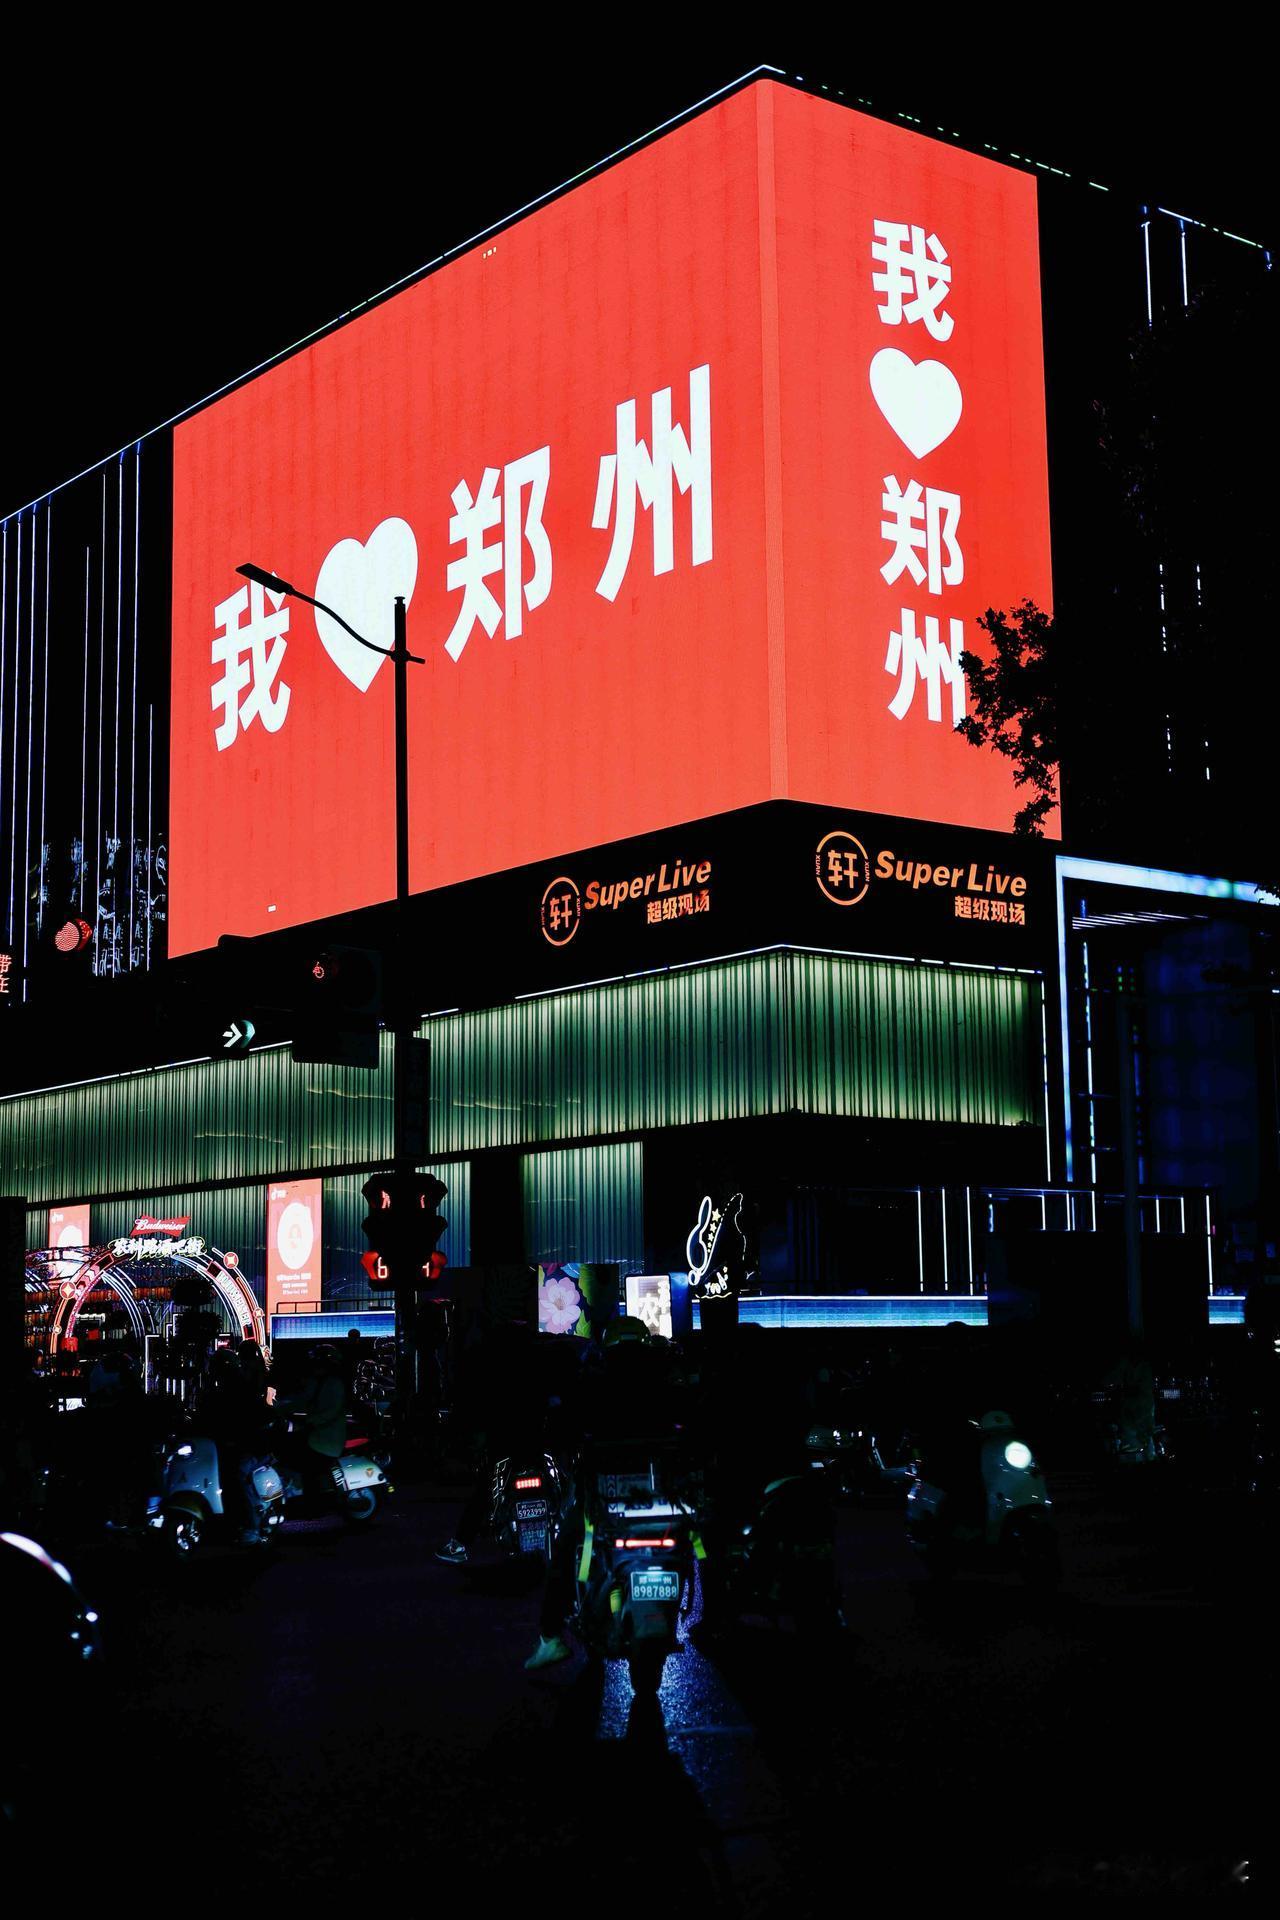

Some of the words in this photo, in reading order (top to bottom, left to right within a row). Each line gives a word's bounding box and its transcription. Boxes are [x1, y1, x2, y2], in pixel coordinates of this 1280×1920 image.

[872, 219, 954, 342] 我
[211, 571, 291, 752] 我
[444, 364, 713, 663] 郑州
[880, 474, 967, 729] 郑州
[828, 849, 859, 889] 轩
[550, 894, 572, 931] 轩
[647, 889, 710, 925] 超级现场
[954, 895, 1026, 926] 超级现场
[135, 1219, 186, 1231] Budweiser
